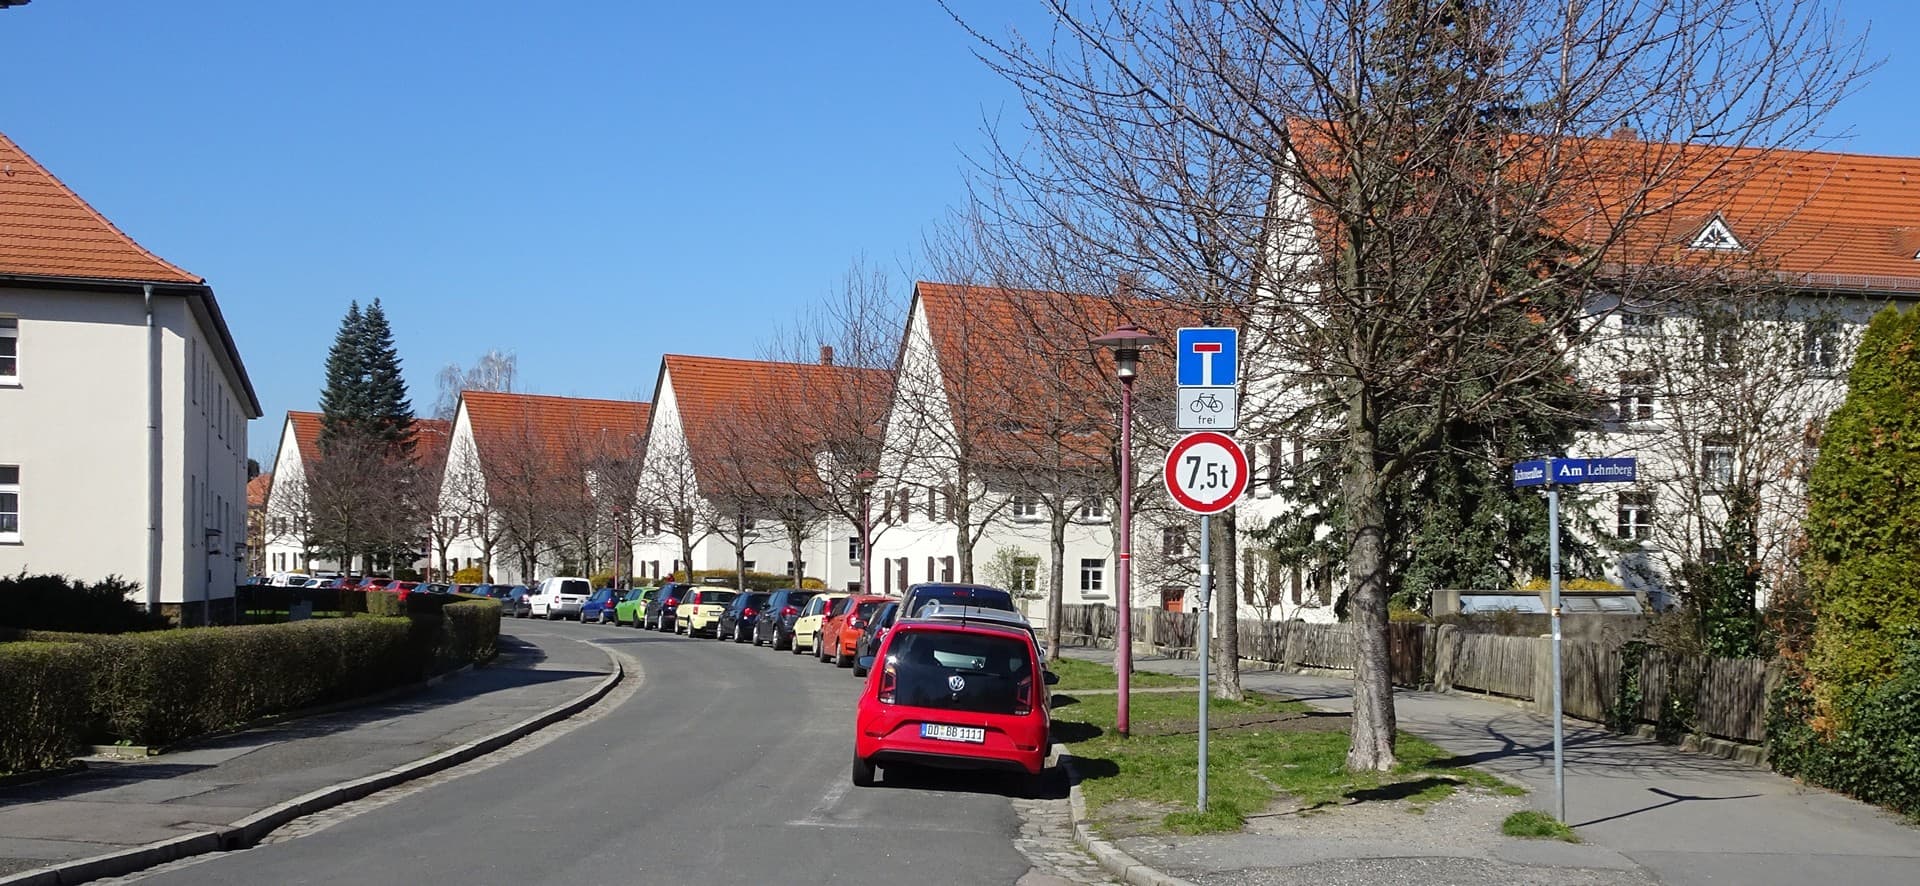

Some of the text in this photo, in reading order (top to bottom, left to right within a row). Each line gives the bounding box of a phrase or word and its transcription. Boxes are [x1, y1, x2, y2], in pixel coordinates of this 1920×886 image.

[1198, 415, 1216, 425] frei
[1559, 464, 1632, 476] Am Lehmberg
[927, 724, 982, 740] DD BB 1111
